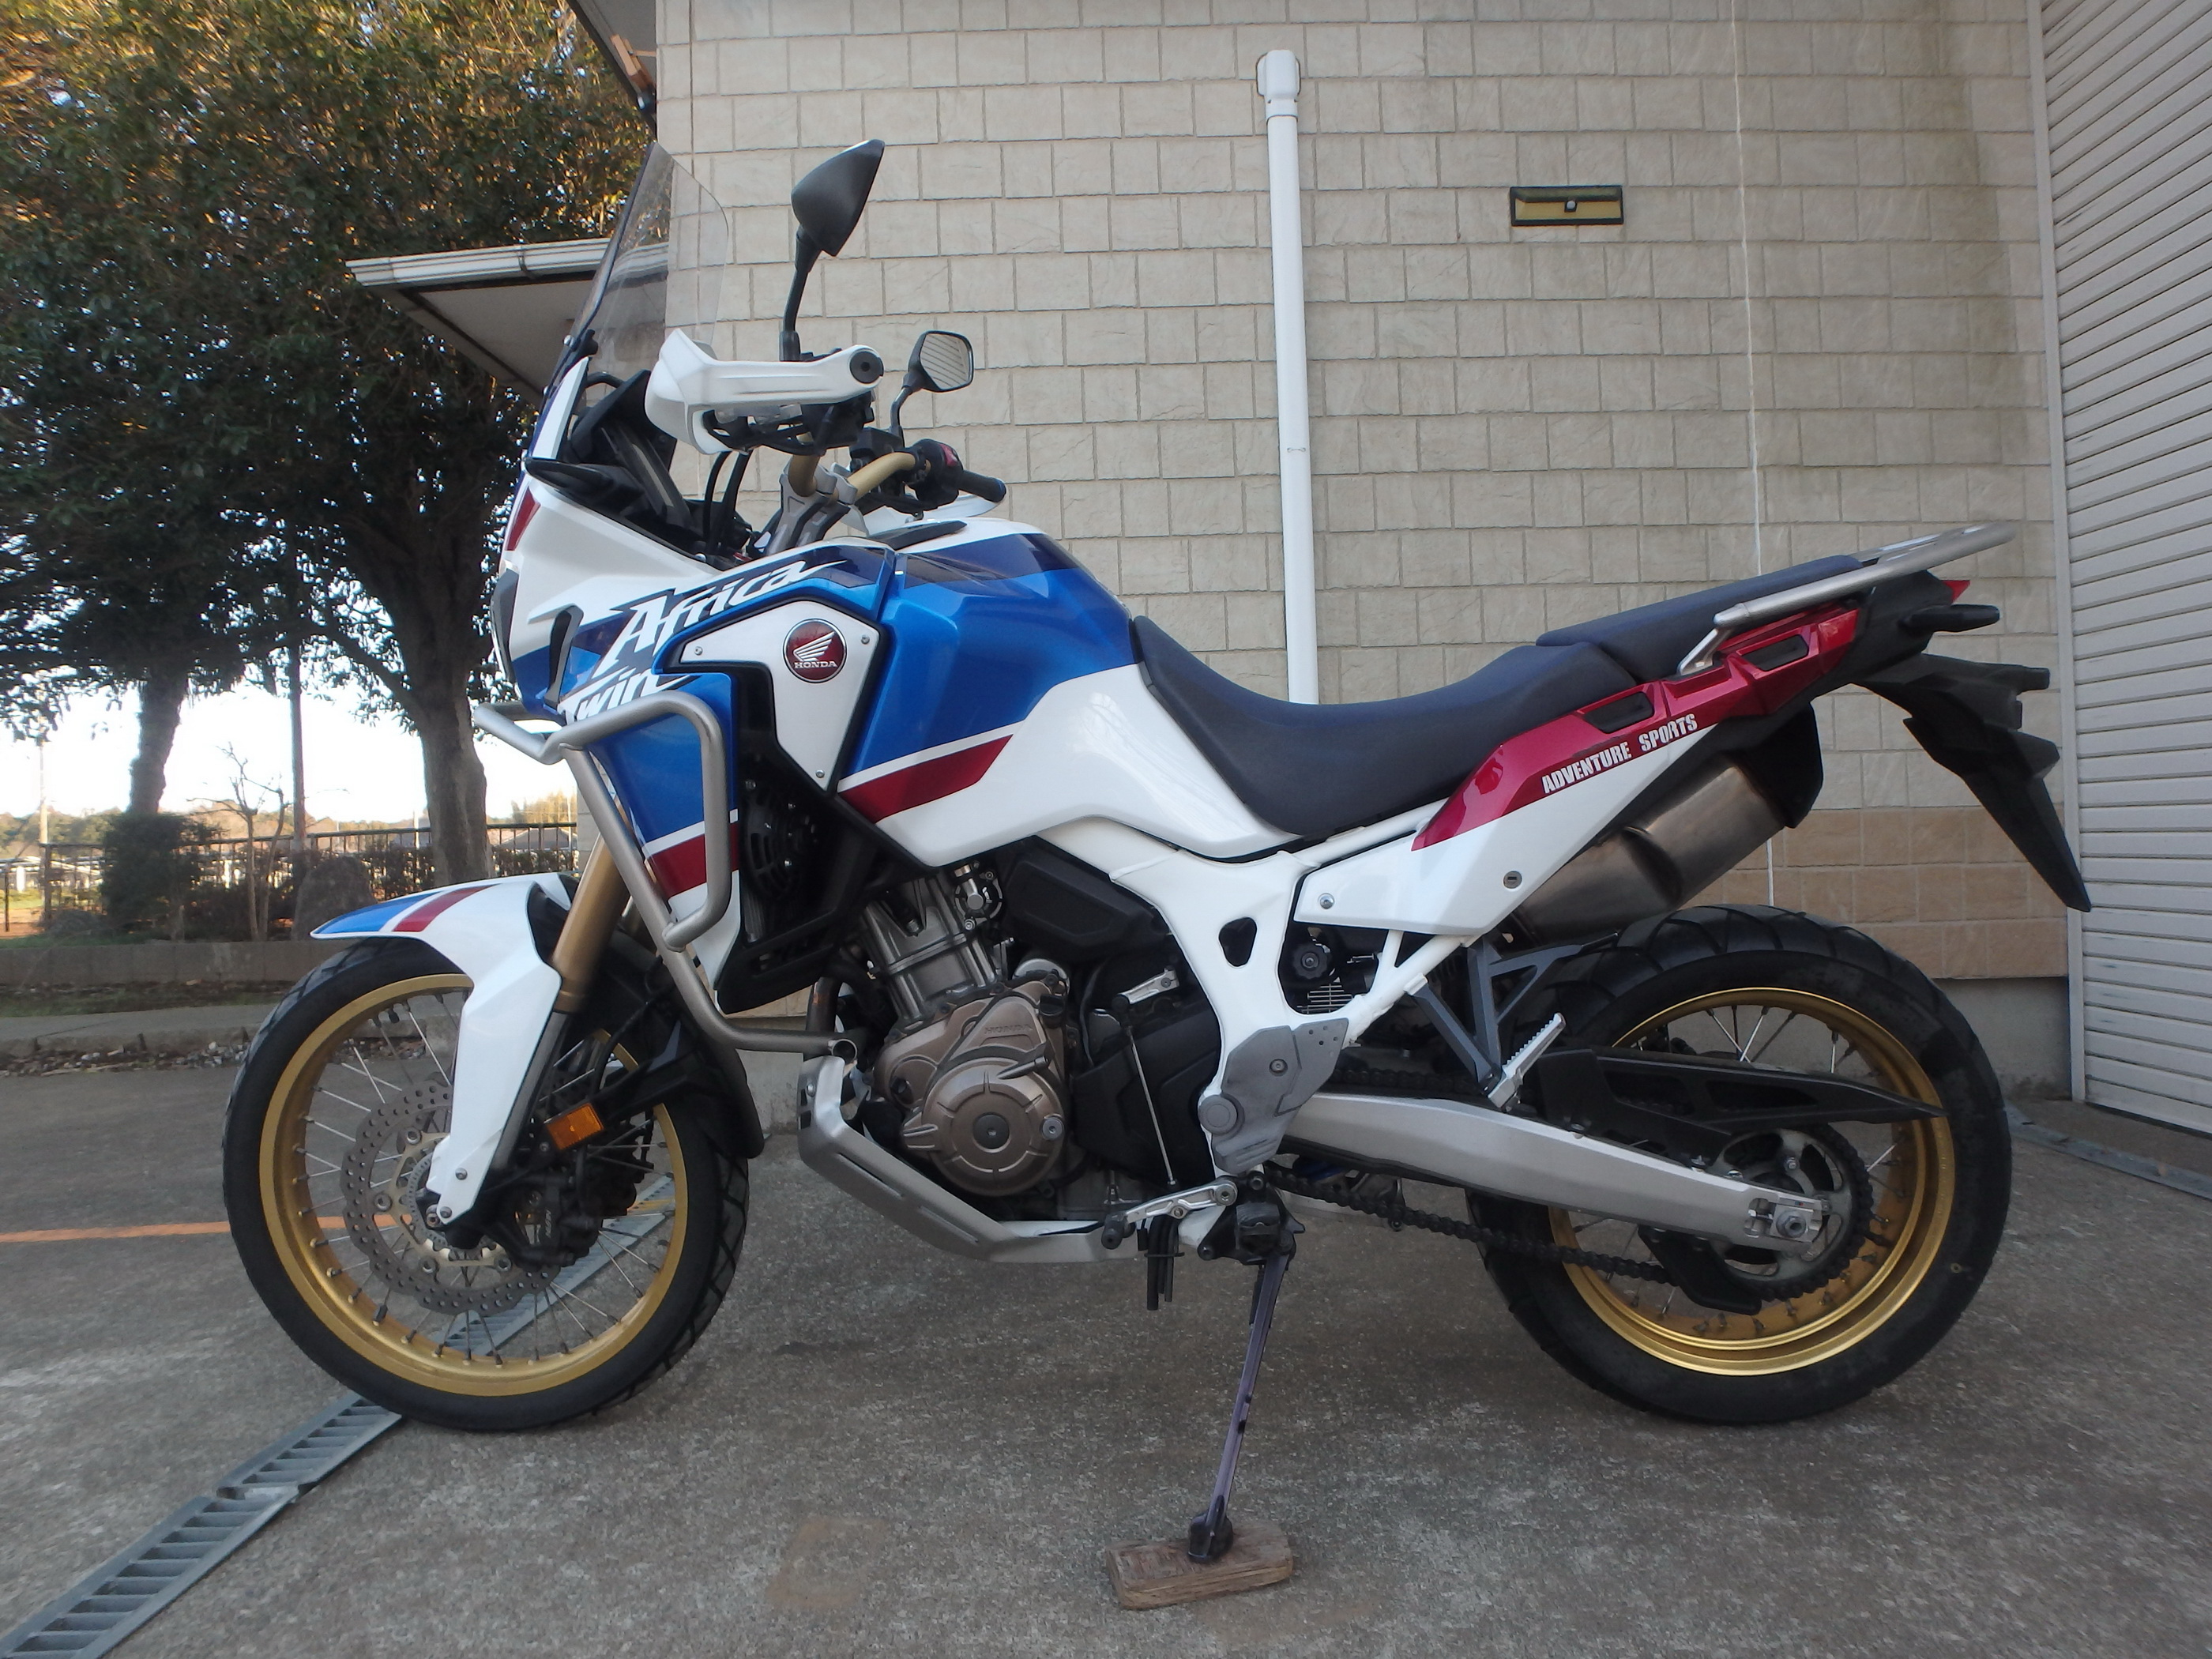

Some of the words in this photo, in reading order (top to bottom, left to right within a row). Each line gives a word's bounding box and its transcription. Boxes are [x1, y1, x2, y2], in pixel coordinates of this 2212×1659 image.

[592, 560, 847, 679] Africa
[794, 660, 837, 669] HONDA
[1541, 741, 1632, 794] ADVENTURE
[1638, 713, 1698, 752] SPORTS
[984, 1025, 1033, 1035] HONDA
